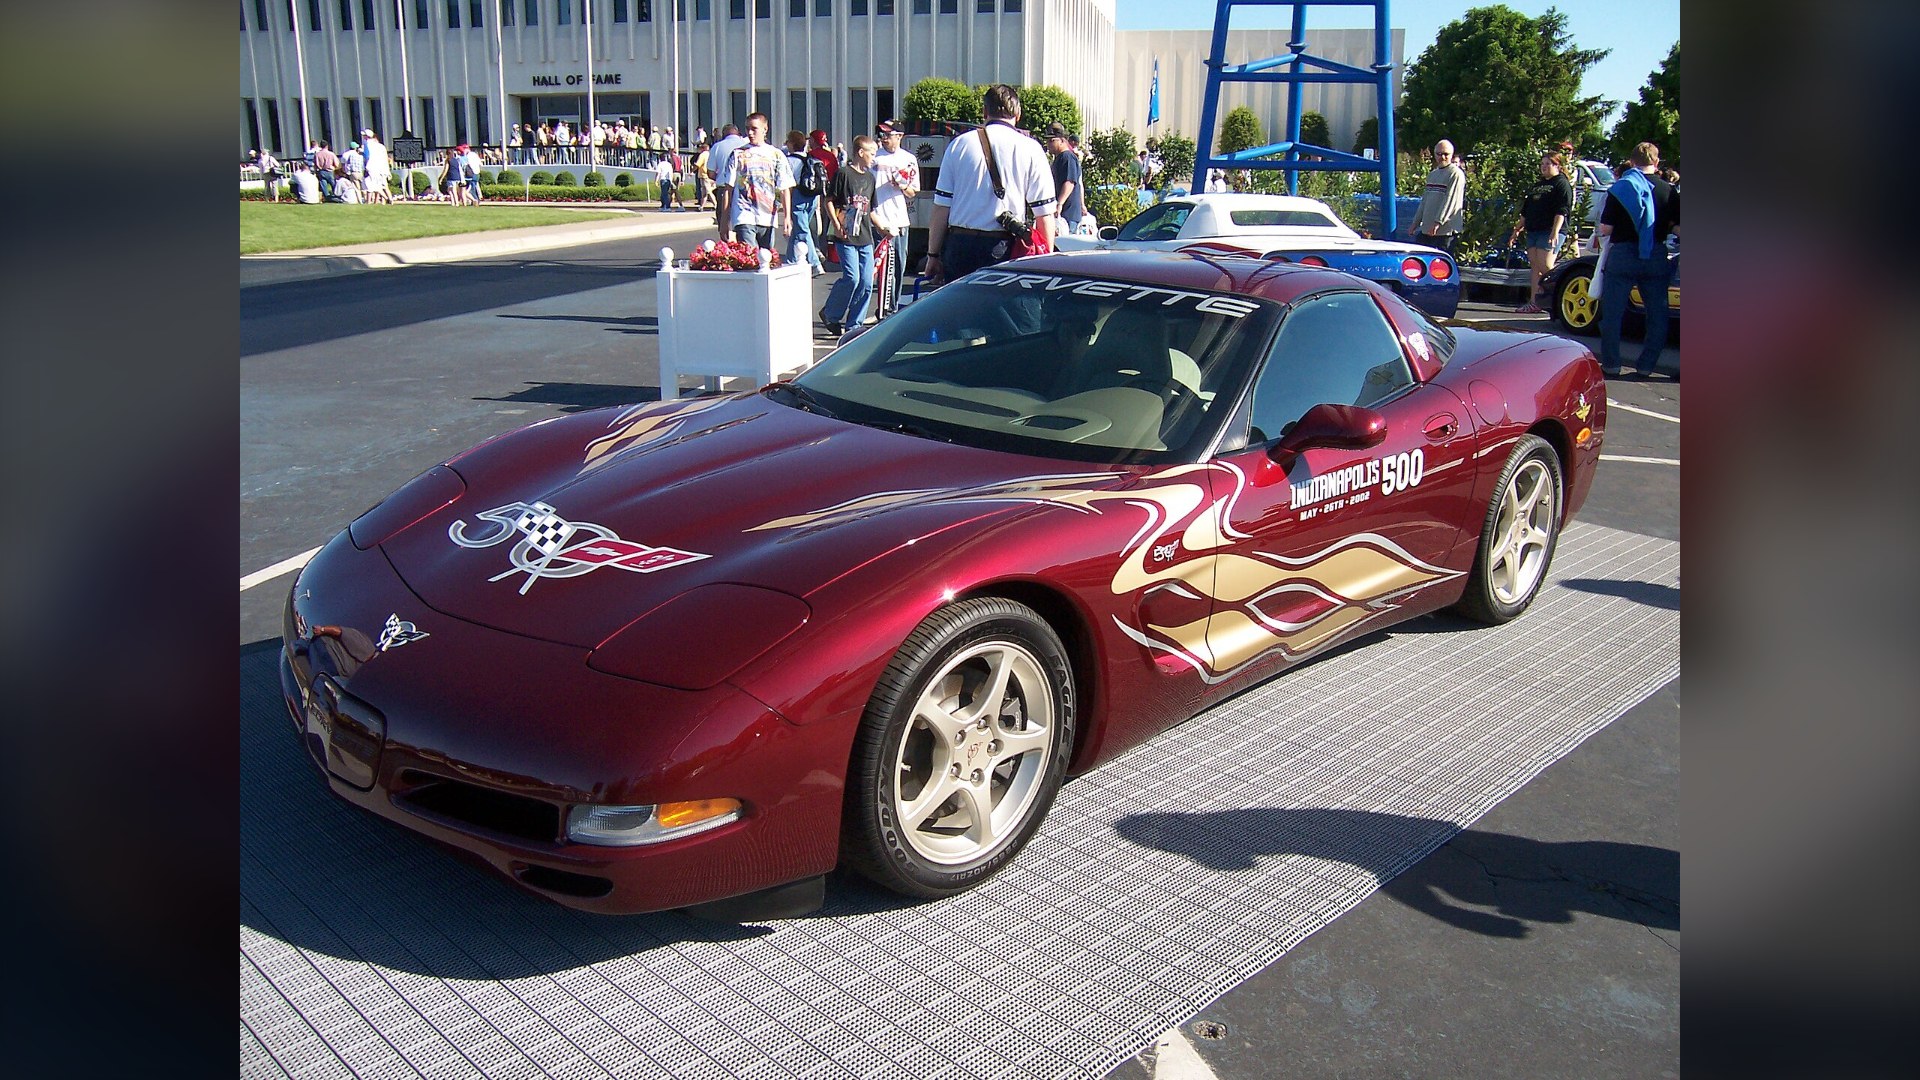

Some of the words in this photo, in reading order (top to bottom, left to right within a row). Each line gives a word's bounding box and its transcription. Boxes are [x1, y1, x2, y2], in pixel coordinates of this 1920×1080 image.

[532, 75, 561, 86] HALL
[565, 74, 583, 85] OF
[1289, 459, 1380, 510] INDIANAPOLIS
[1381, 448, 1424, 496] 500
[1300, 507, 1318, 521] MAY
[1323, 499, 1345, 513] 26TH
[1350, 491, 1370, 505] 2002
[1050, 654, 1072, 747] EAGLE
